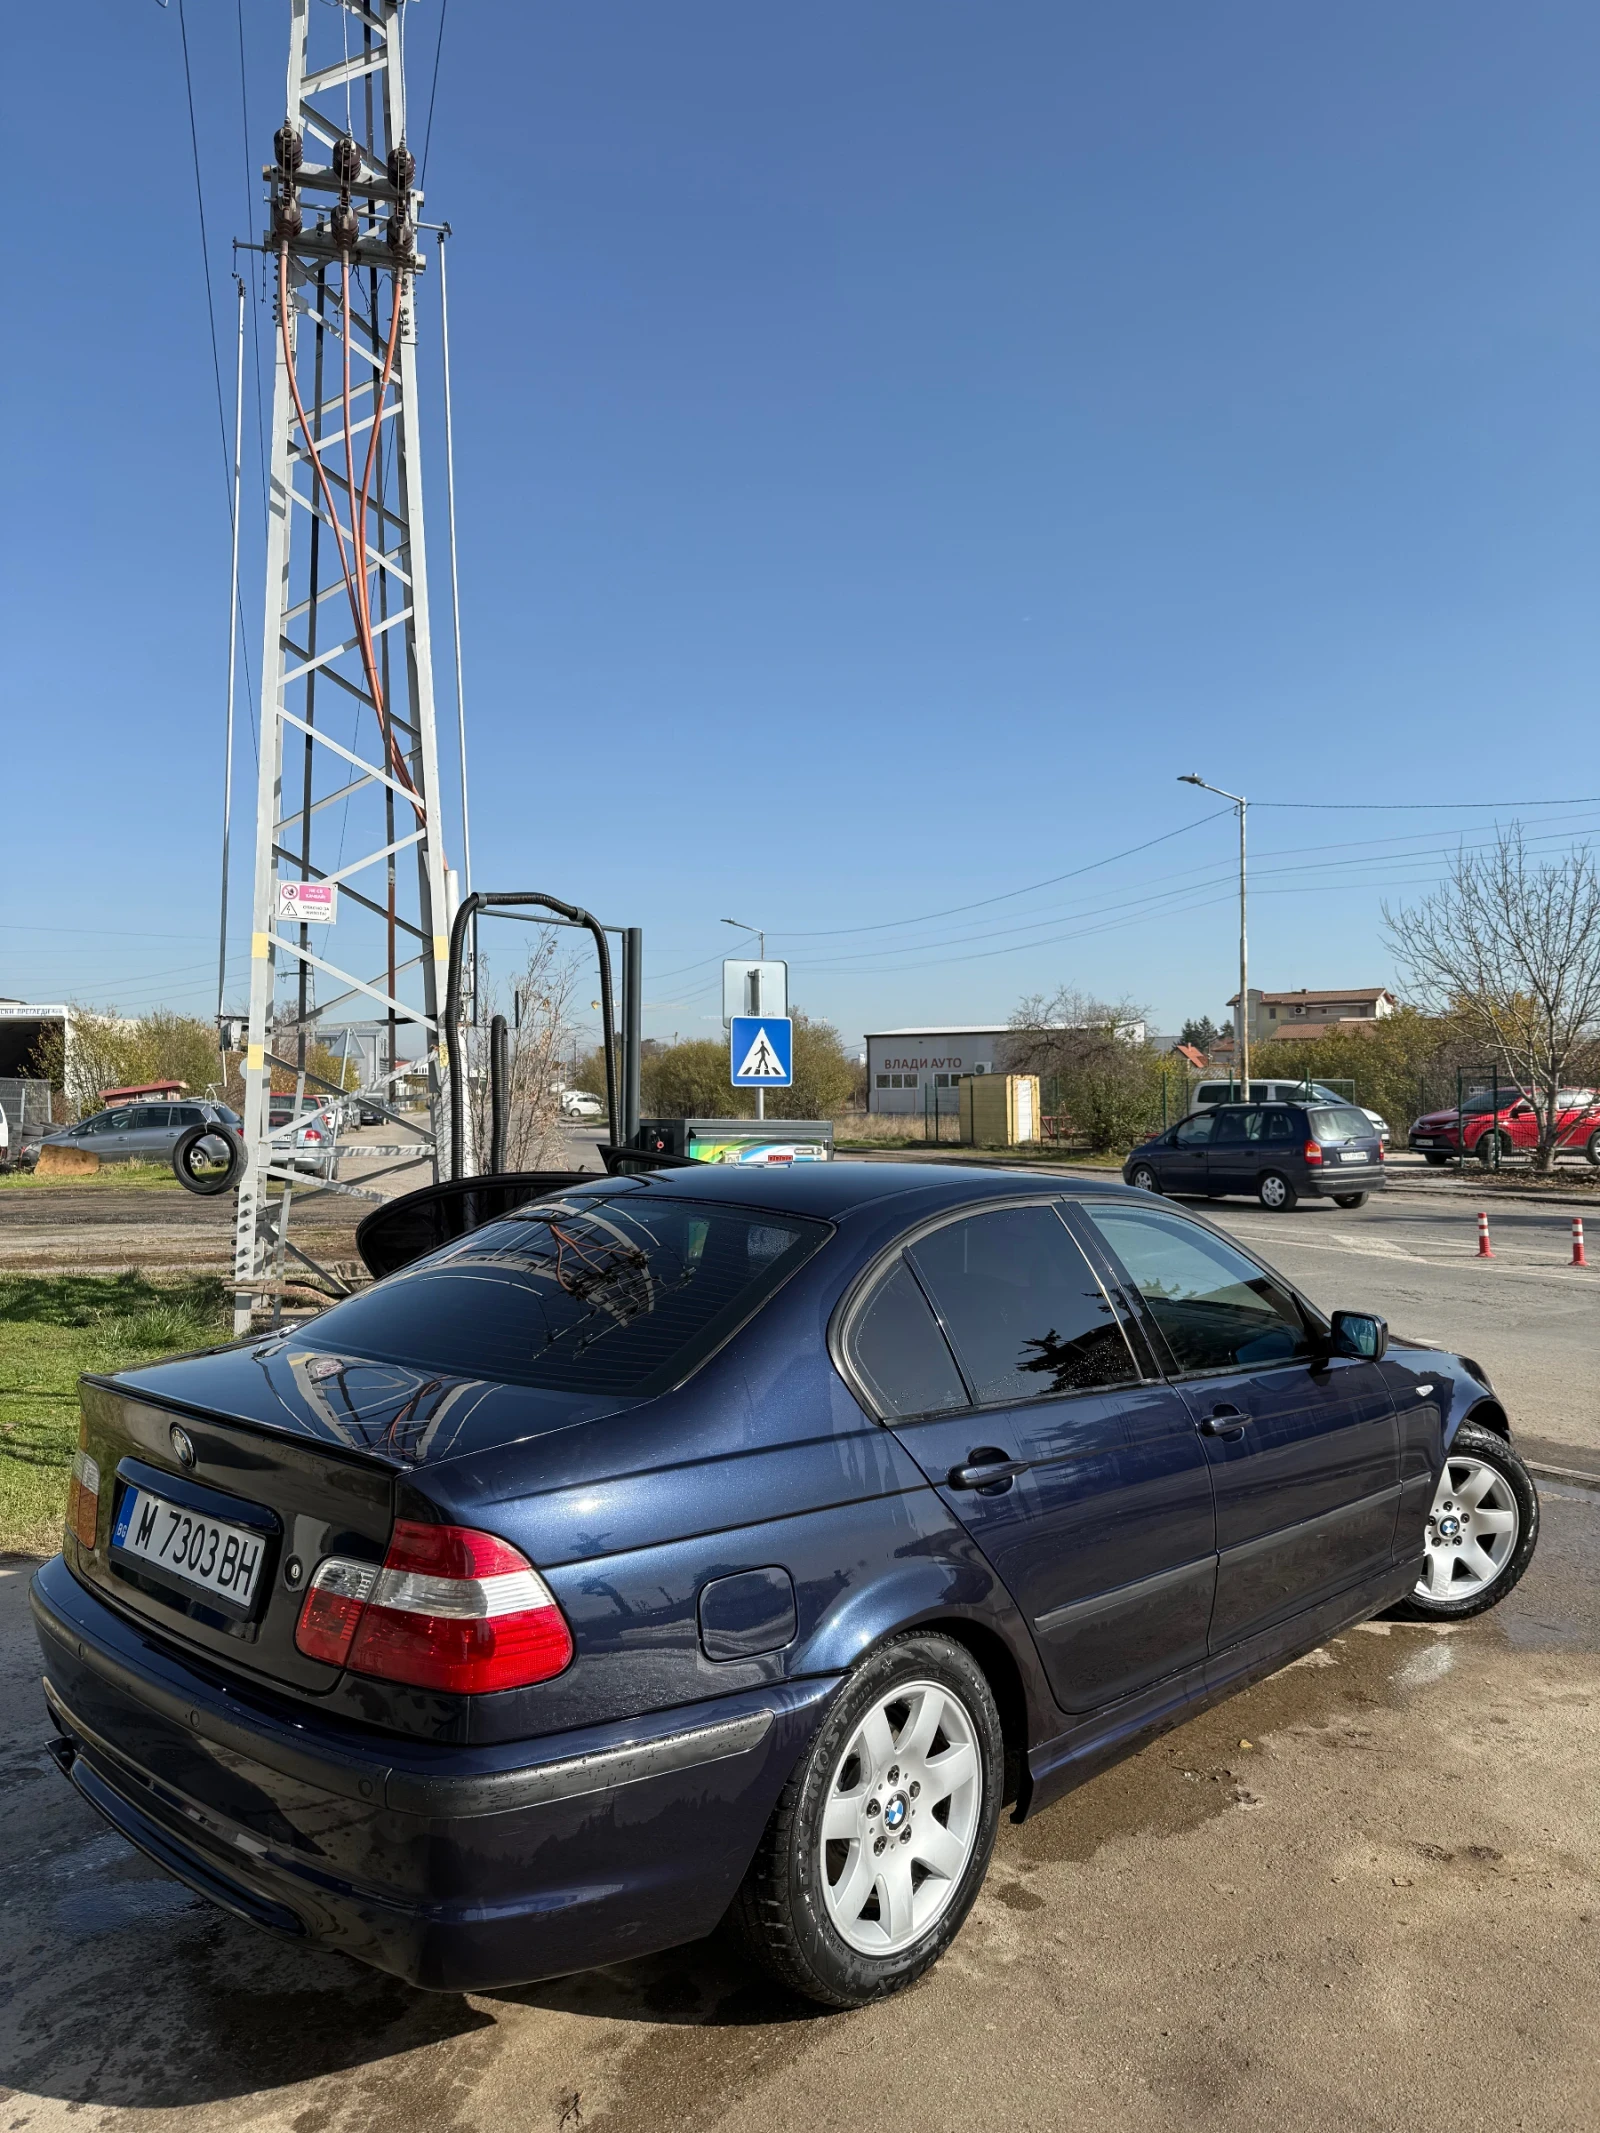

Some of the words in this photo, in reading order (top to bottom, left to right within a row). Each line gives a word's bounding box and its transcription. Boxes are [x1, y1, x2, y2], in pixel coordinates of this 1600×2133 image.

[17, 1008, 50, 1016] ПРЕГЛЕДИ
[884, 1058, 928, 1071] ВЛАДИ
[930, 1057, 962, 1069] АУТО
[116, 1522, 128, 1538] BG
[134, 1501, 159, 1551] M
